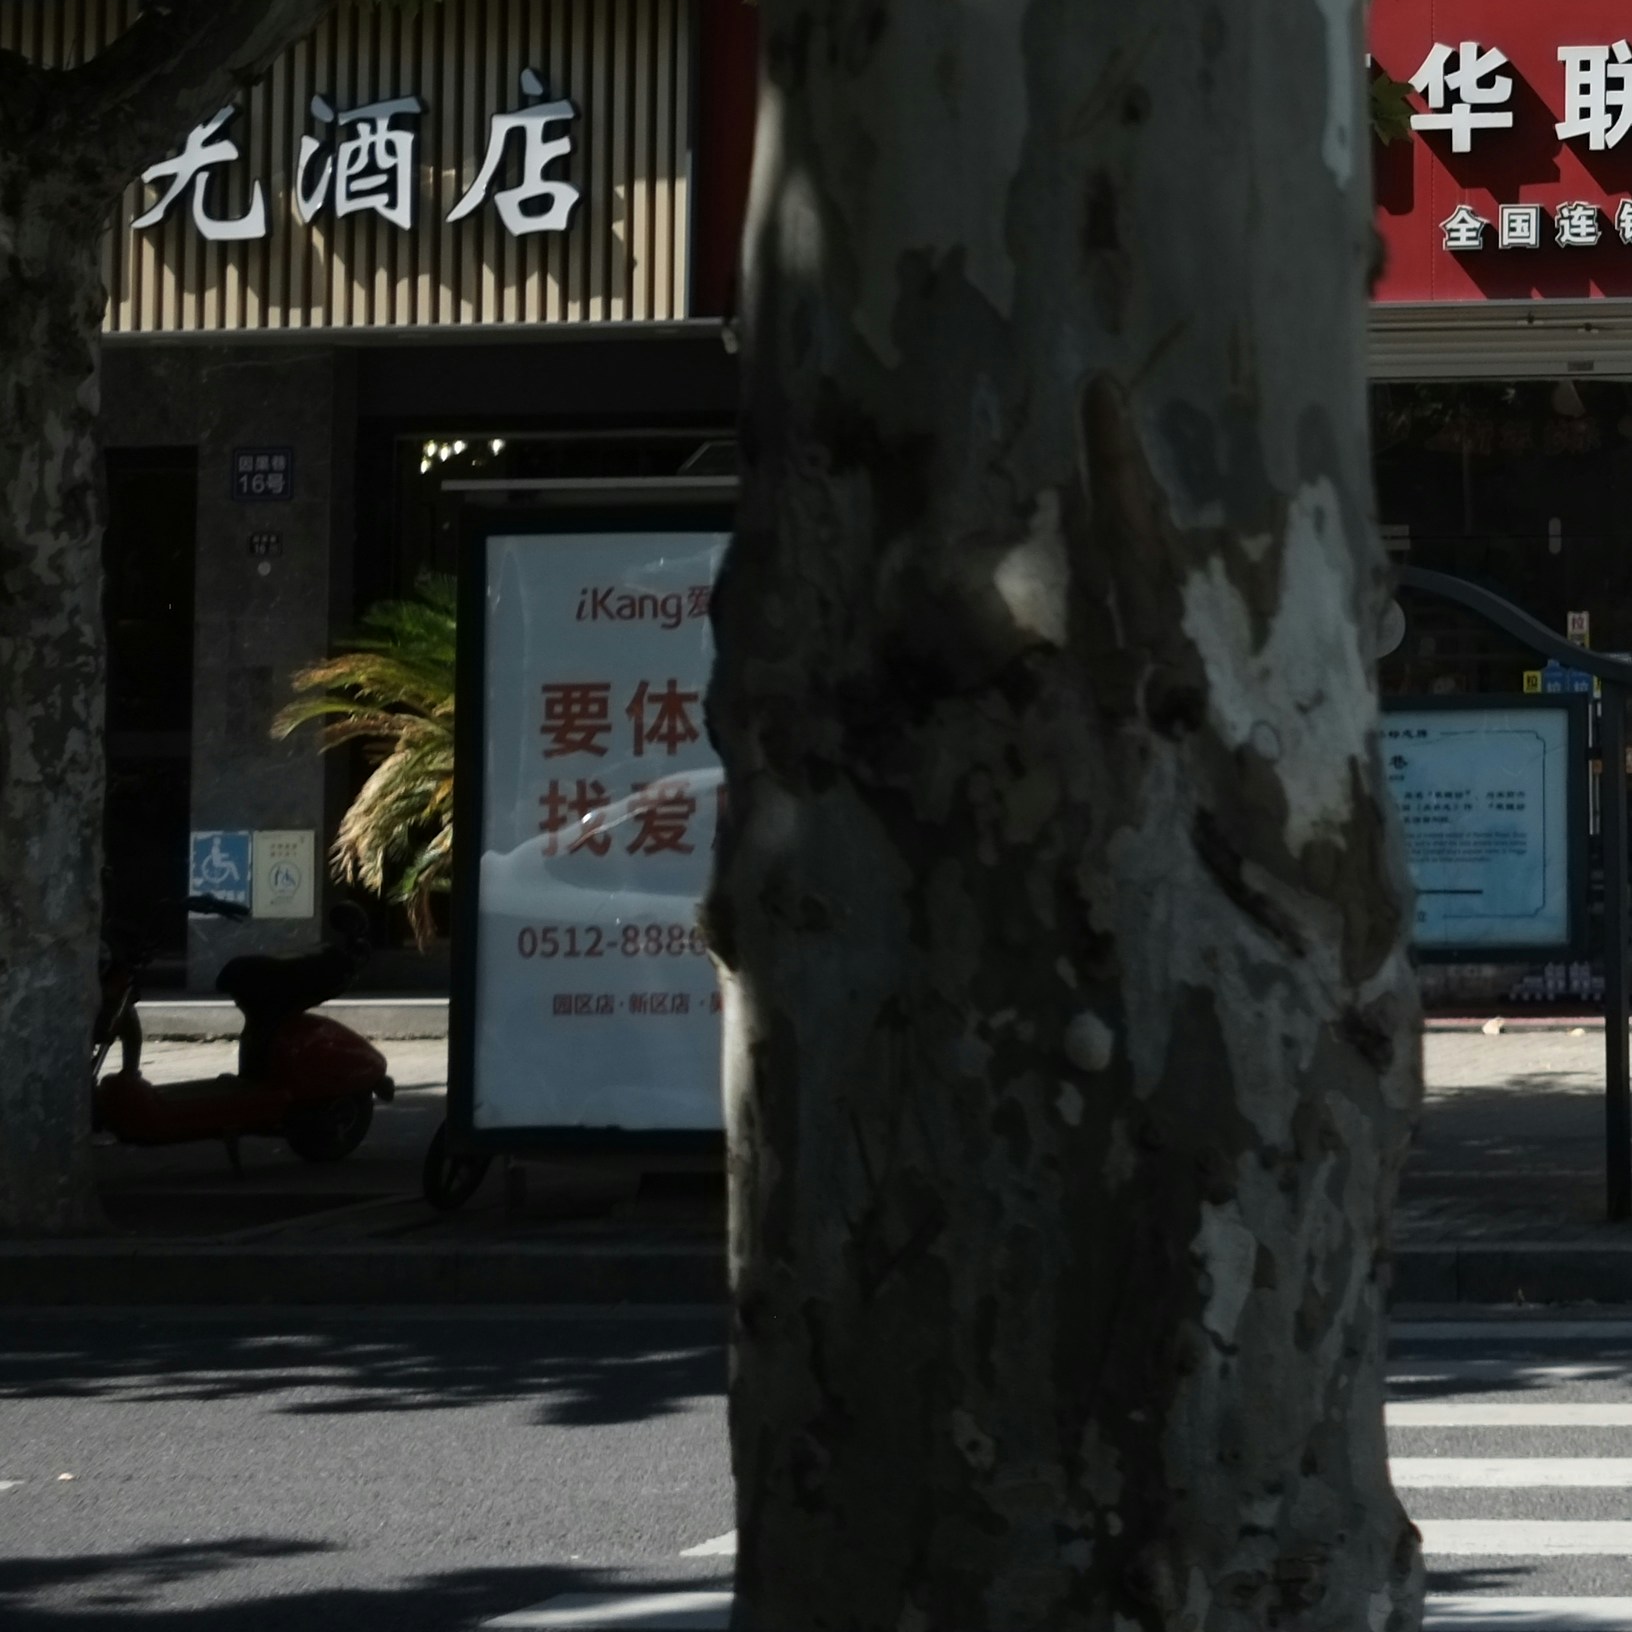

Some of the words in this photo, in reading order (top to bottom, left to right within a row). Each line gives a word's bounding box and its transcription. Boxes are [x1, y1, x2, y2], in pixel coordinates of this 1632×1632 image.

[239, 473, 285, 494] 16号
[576, 586, 682, 629] iKang
[540, 679, 699, 758] 要体
[539, 779, 727, 857] 找爱
